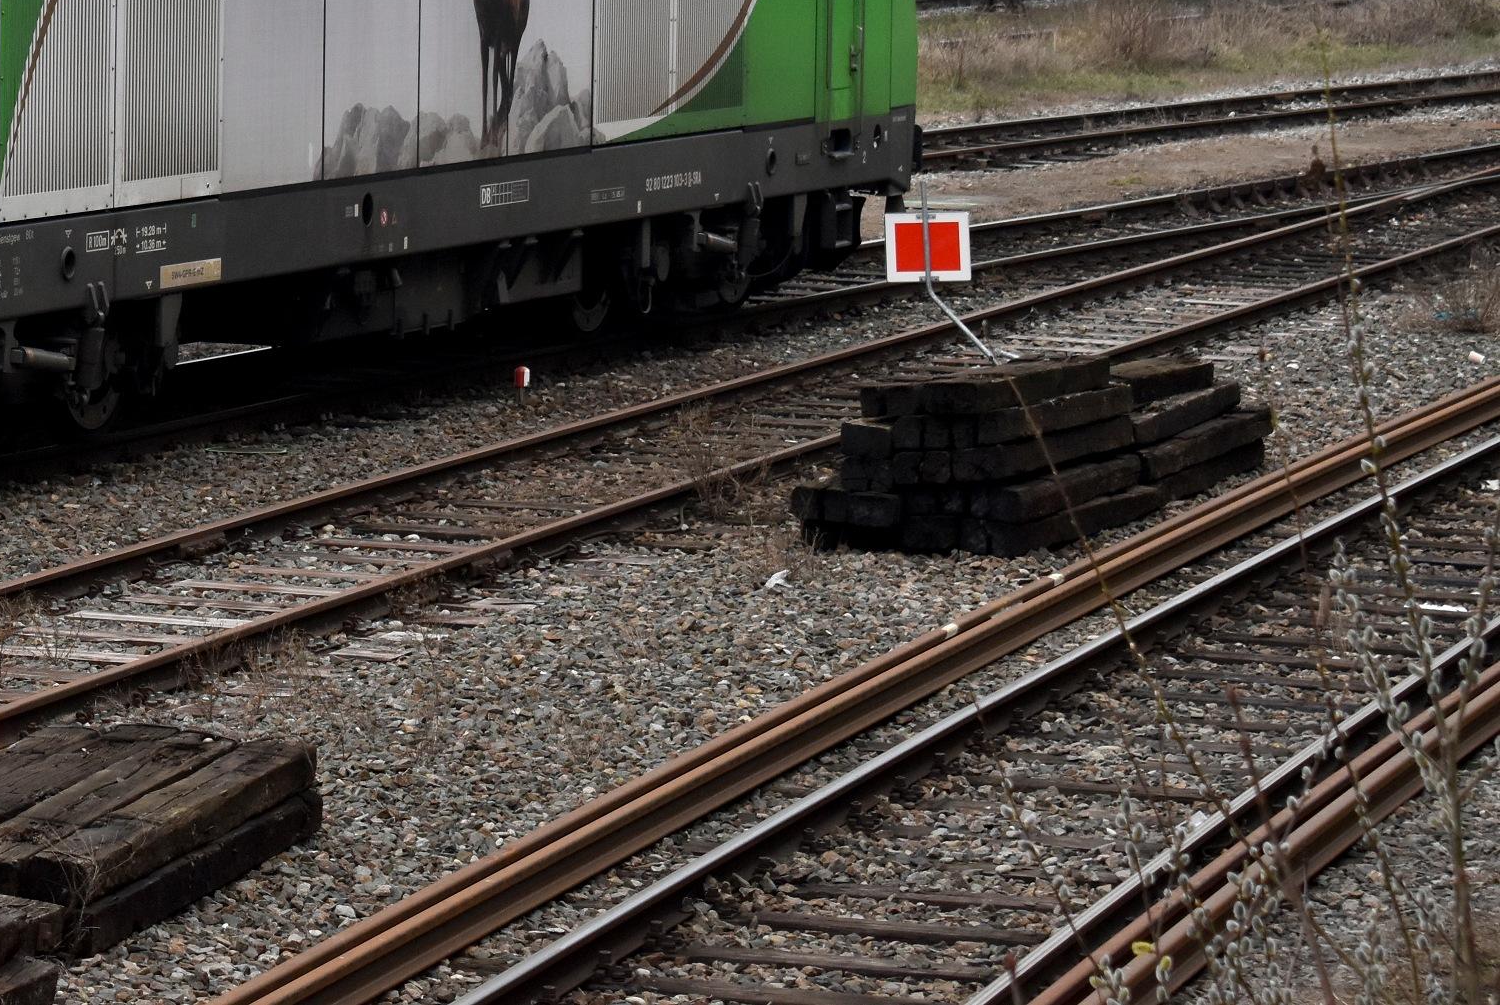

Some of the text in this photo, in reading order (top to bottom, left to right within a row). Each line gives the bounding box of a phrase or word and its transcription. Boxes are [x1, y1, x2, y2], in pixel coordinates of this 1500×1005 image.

[482, 187, 492, 205] DB
[142, 225, 156, 237] 19.28
[142, 238, 156, 251] 10.36
